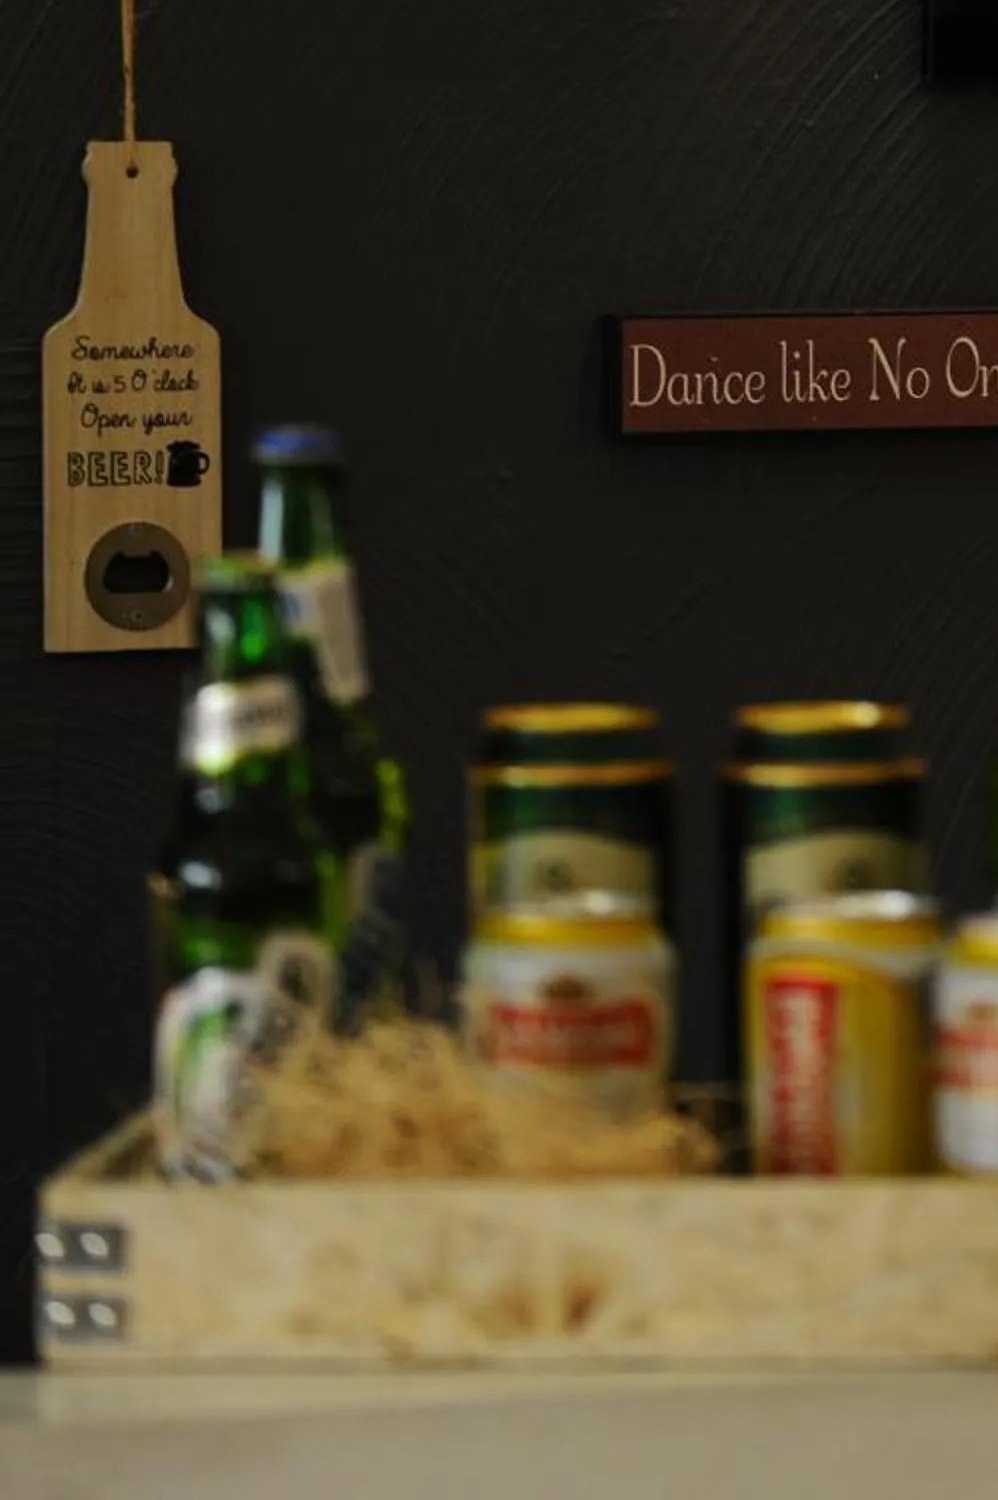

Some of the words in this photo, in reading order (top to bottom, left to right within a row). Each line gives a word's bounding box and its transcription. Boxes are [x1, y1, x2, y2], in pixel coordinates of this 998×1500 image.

[70, 334, 196, 361] Somewhere
[113, 373, 127, 394] 5
[627, 342, 767, 408] Dance
[777, 338, 854, 404] like
[866, 336, 932, 402] No
[79, 401, 137, 437] Open
[140, 410, 194, 437] your
[65, 450, 165, 488] BEER!
